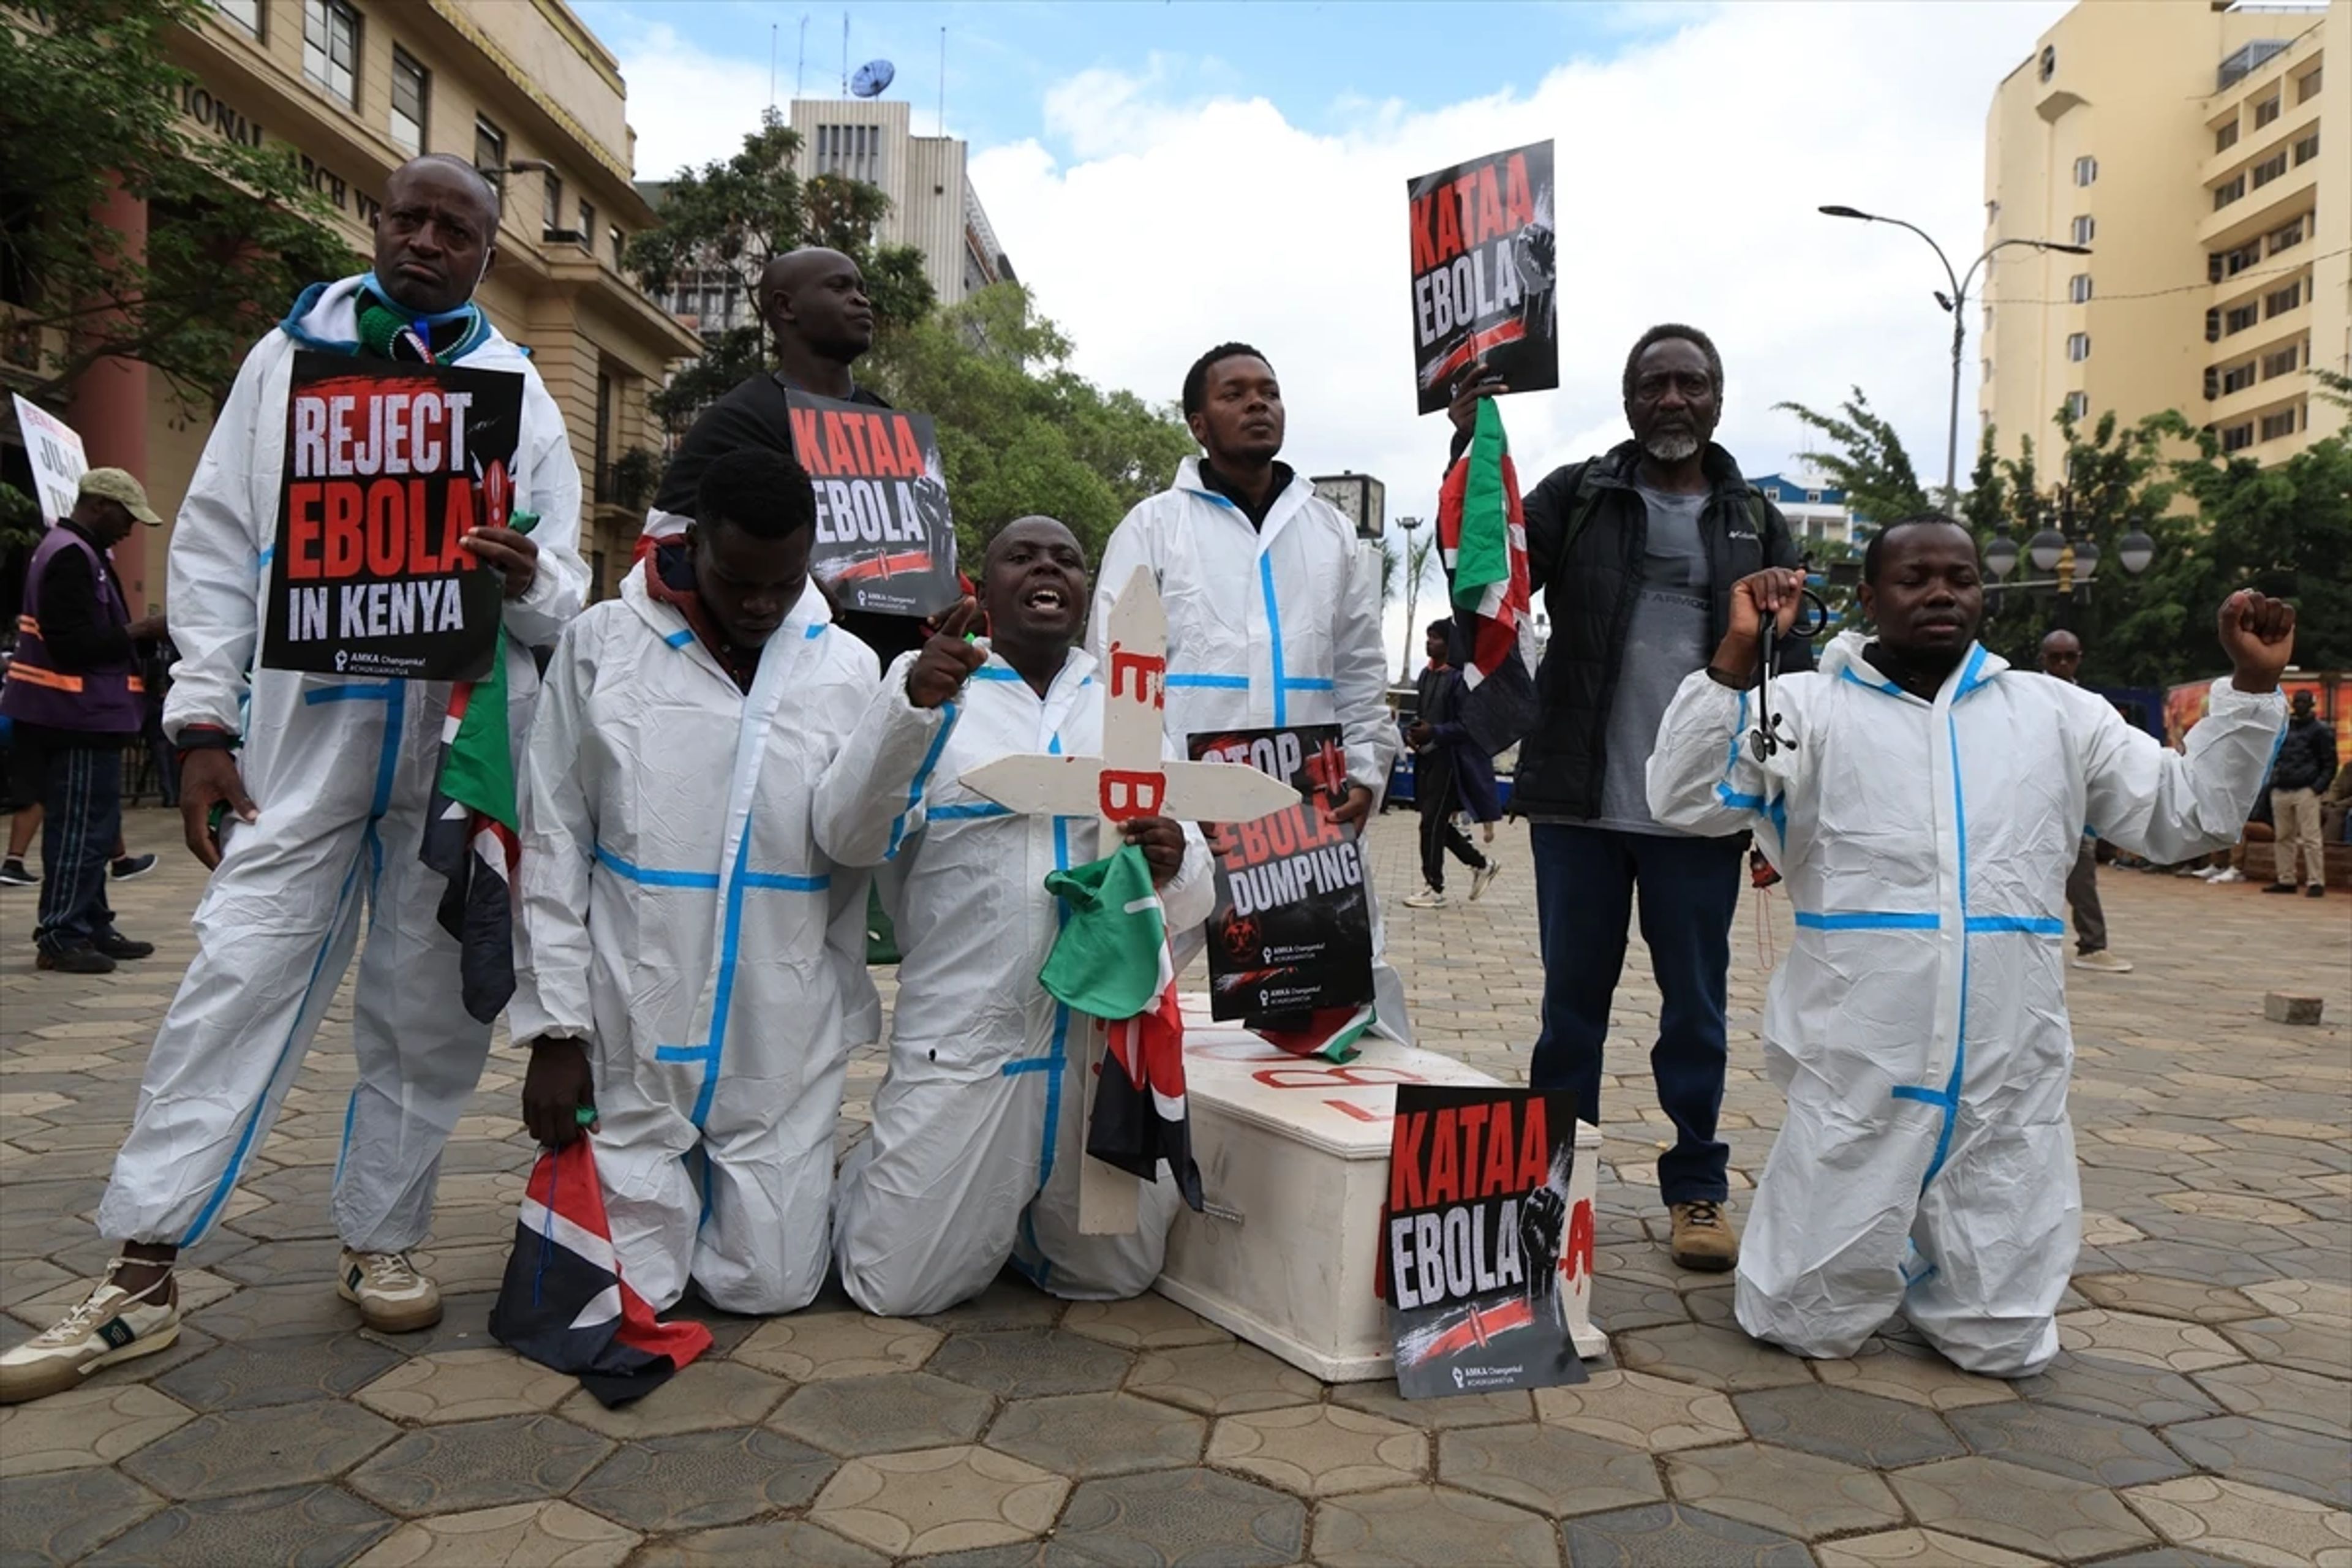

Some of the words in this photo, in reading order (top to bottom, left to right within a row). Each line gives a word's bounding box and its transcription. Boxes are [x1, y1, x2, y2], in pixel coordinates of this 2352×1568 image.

[1411, 153, 1534, 274] KATAA
[1414, 238, 1520, 347] EBOLA
[295, 392, 473, 477] REJECT
[790, 408, 925, 477] KATAA
[287, 478, 477, 579] EBOLA
[811, 480, 925, 543] EBOLA
[288, 587, 328, 641] IN
[340, 579, 464, 638] KENYA
[1201, 732, 1302, 788] OP
[1229, 842, 1362, 918] DUMPING
[1391, 1097, 1548, 1212] KATAA
[1391, 1199, 1523, 1310] EBOLA
